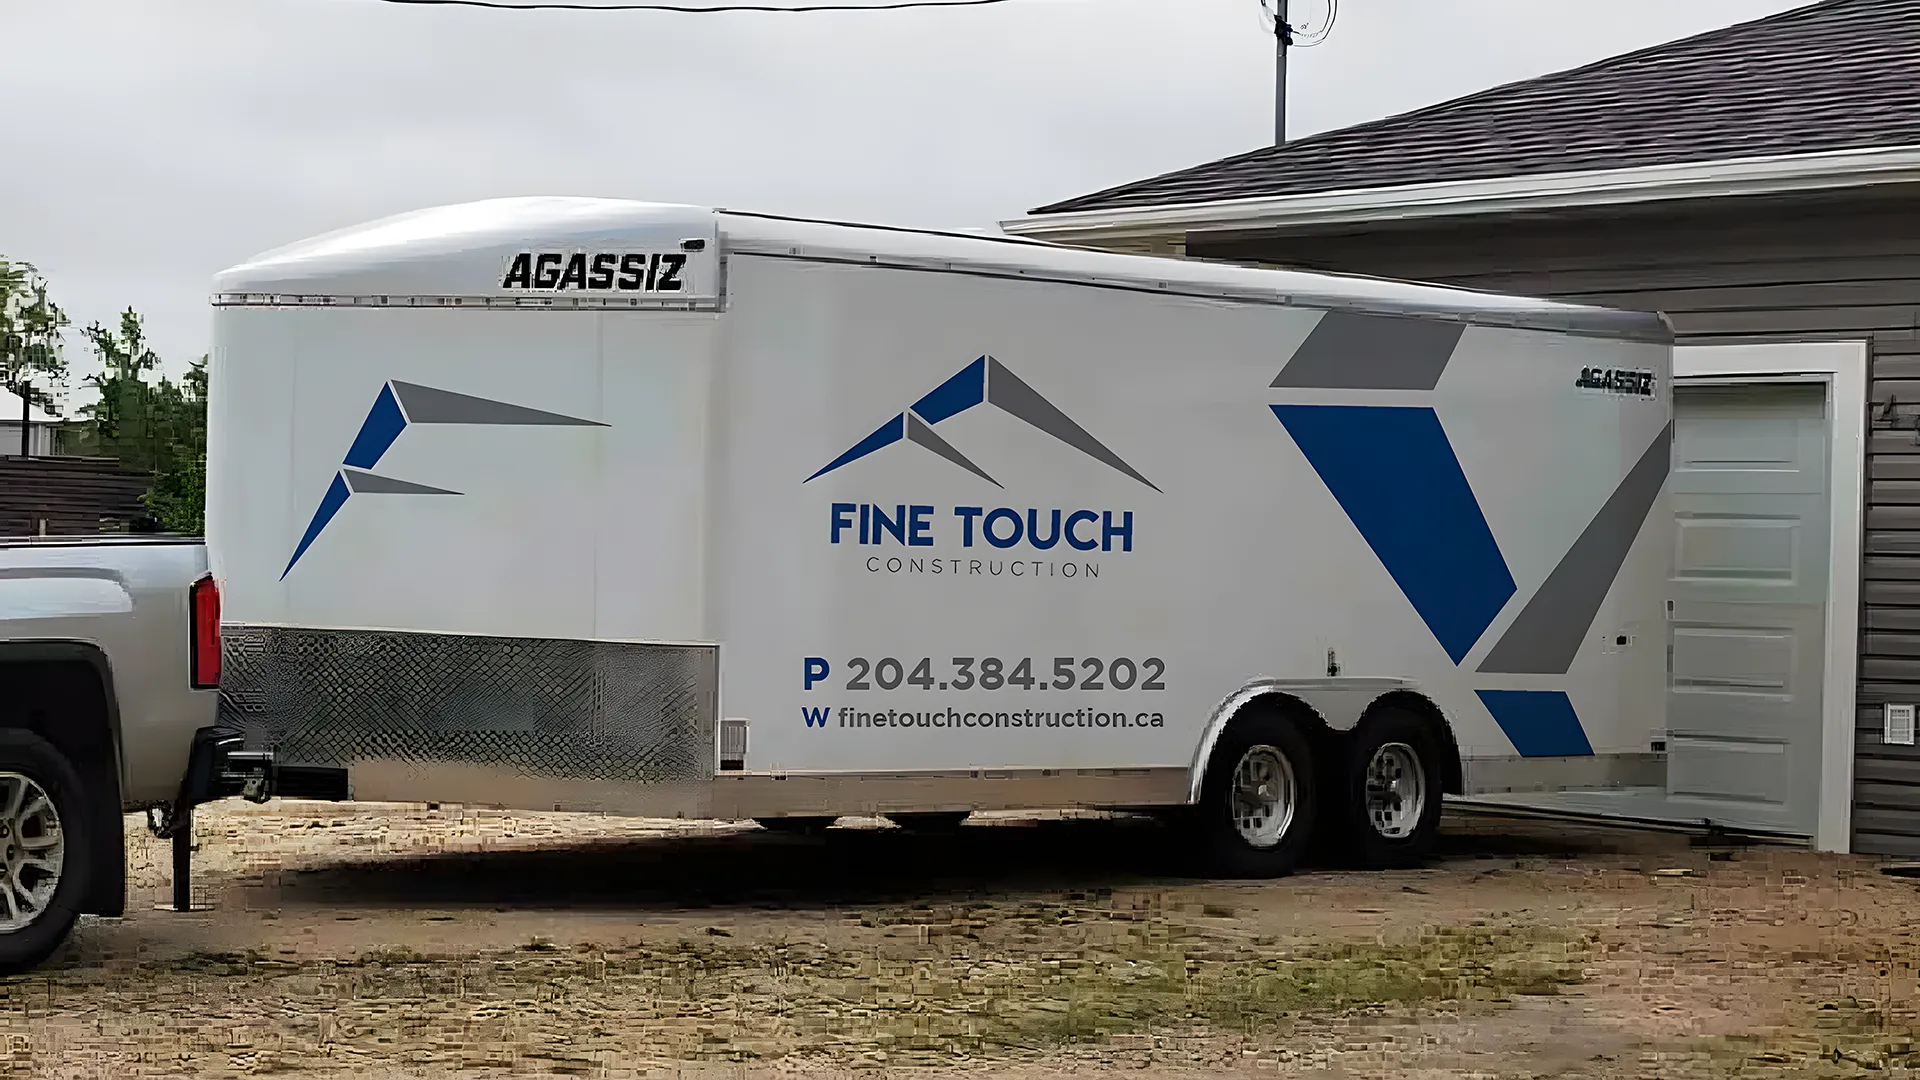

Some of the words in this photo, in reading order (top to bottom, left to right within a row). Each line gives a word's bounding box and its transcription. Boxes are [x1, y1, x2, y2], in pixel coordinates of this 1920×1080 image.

[503, 253, 687, 290] AGASSIZ
[830, 502, 935, 547] FINE
[953, 506, 1134, 552] TOUCH
[865, 556, 1099, 578] CONSTRUCTION
[803, 657, 830, 691] P
[845, 656, 1166, 691] 204.384.5202
[801, 706, 831, 728] W
[837, 706, 1164, 728] finetouchconstruction.ca
